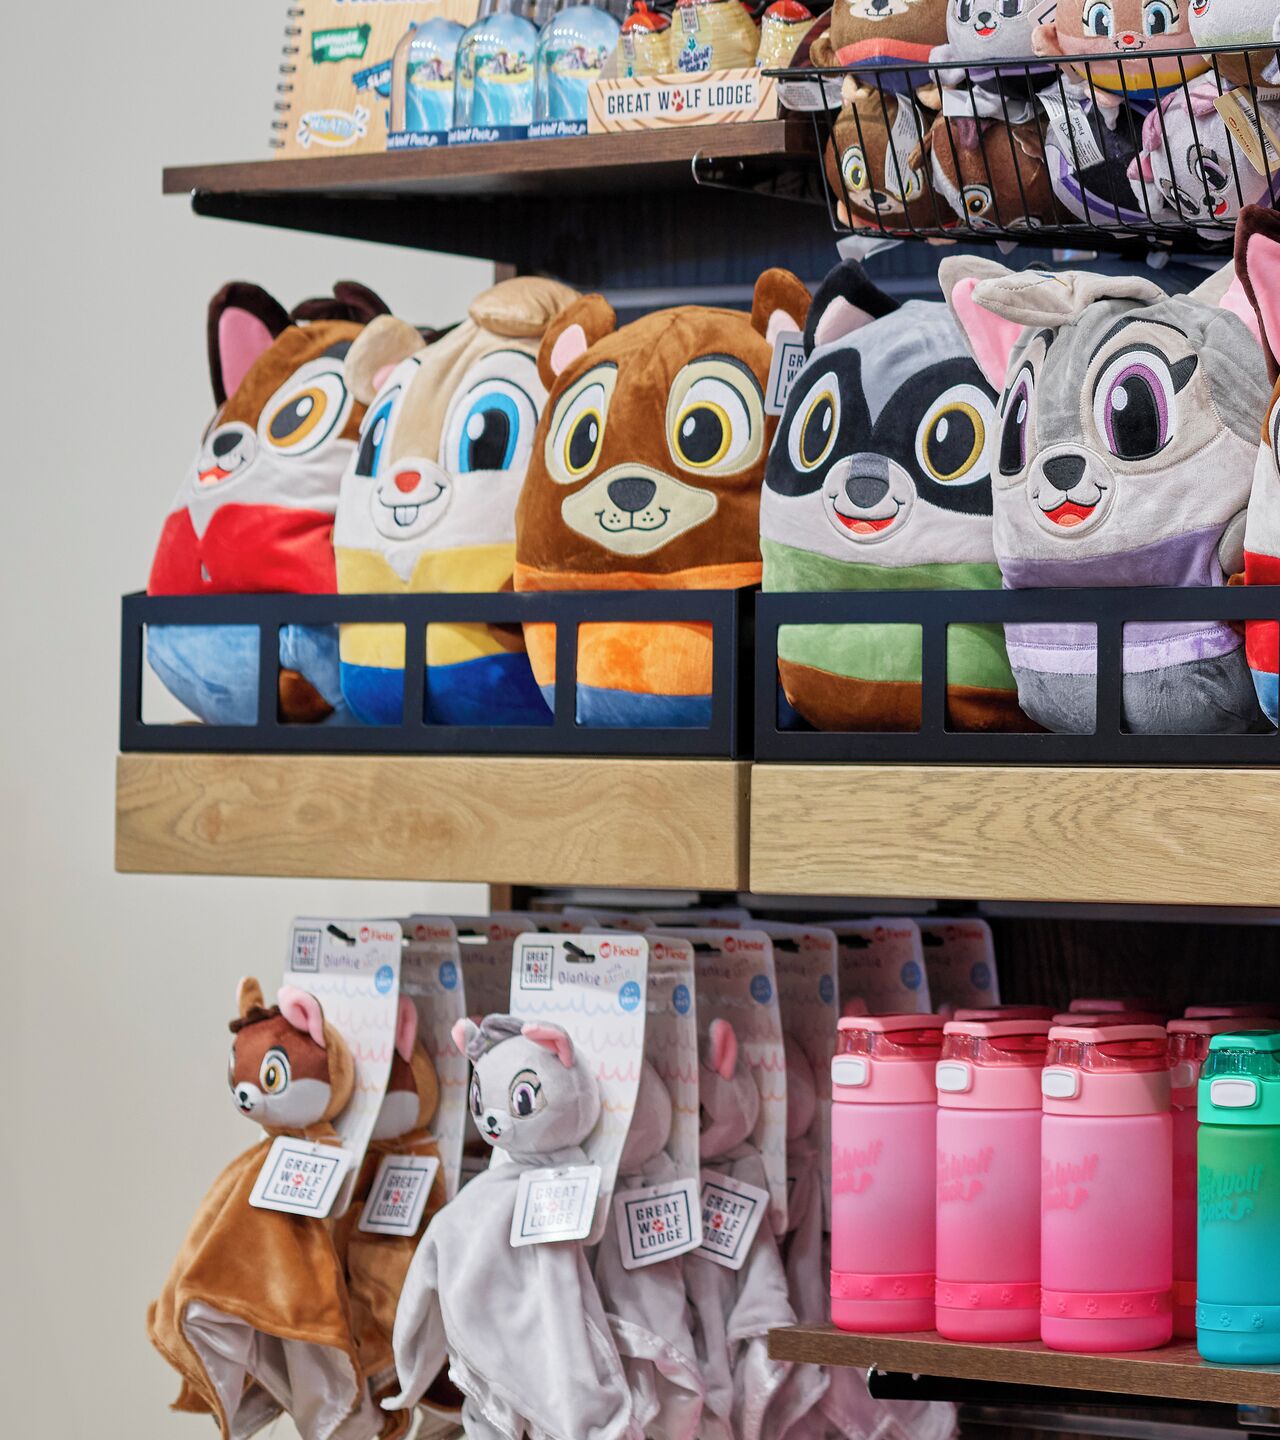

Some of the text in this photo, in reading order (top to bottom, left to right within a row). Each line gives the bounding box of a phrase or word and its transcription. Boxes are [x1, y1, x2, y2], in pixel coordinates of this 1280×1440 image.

[608, 92, 651, 115] GREAT
[708, 84, 752, 107] LODGE
[526, 950, 550, 961] GREAT
[612, 943, 641, 958] Fiesta
[284, 1158, 327, 1175] GREAT
[388, 1175, 420, 1189] GREAT
[273, 1184, 317, 1200] LODGE
[535, 1185, 578, 1199] GREAT
[376, 1203, 409, 1218] LODGE
[635, 1200, 680, 1221] GREAT
[705, 1194, 746, 1217] GREAT
[530, 1212, 573, 1228] LODGE
[640, 1230, 683, 1249] LODGE
[703, 1226, 734, 1248] ODGE
